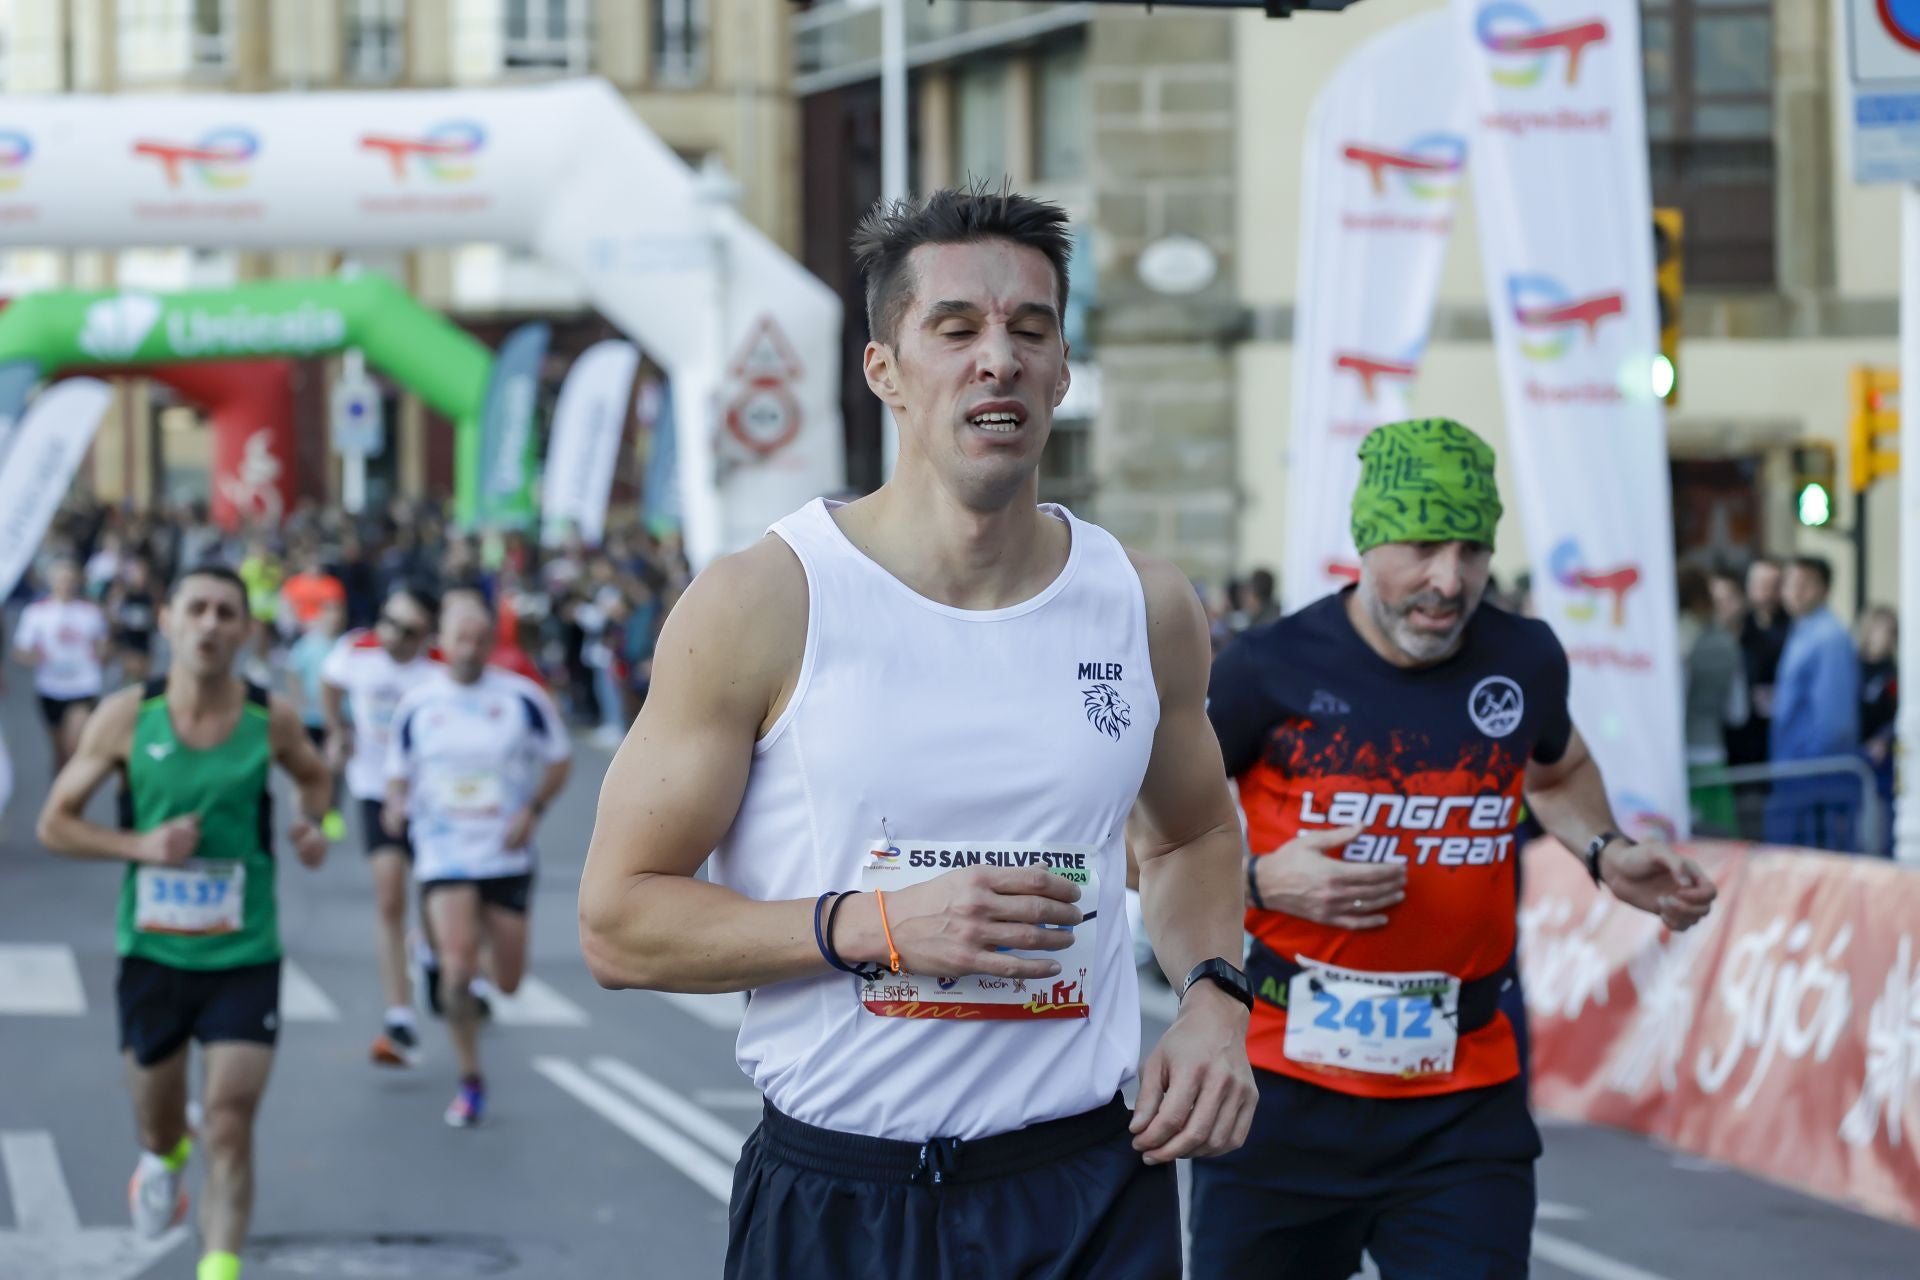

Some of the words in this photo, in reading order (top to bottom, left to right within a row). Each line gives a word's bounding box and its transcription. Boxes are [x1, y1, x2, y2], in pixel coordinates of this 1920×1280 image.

[1077, 662, 1123, 681] MILER
[909, 850, 936, 867] 55
[939, 850, 980, 868] SAN
[985, 851, 1086, 869] SILVESTRE
[1313, 991, 1432, 1039] 2412
